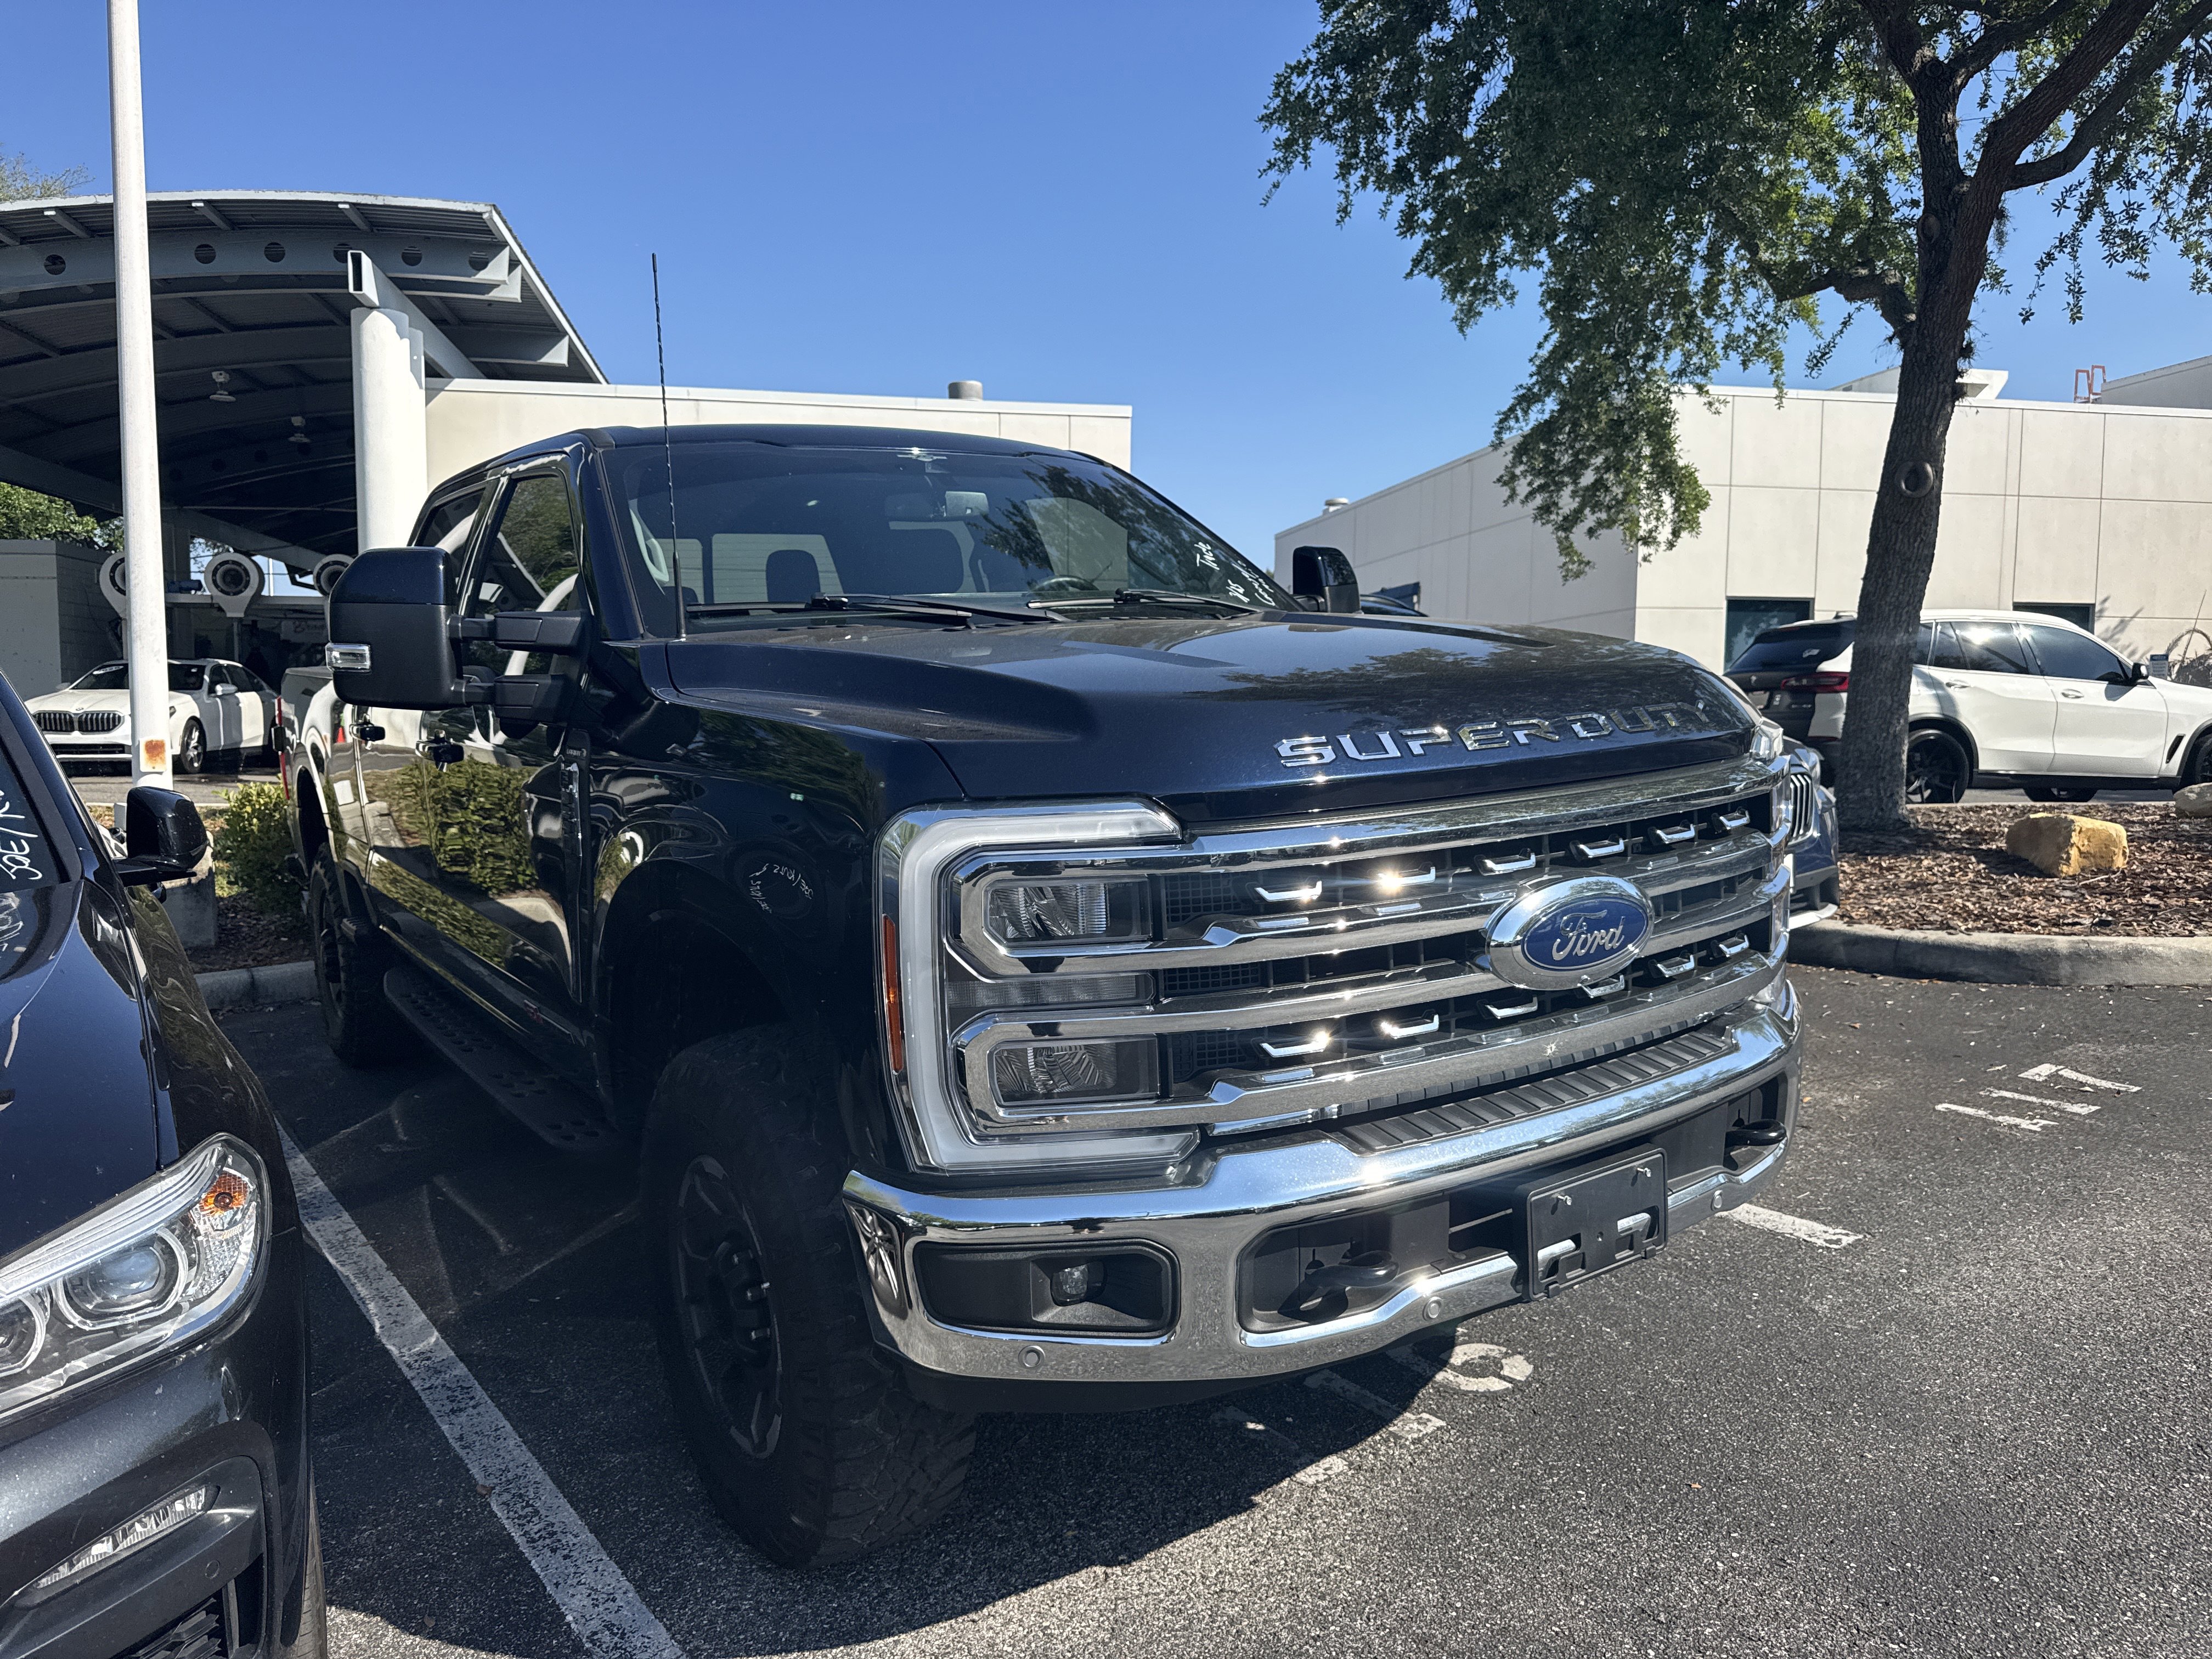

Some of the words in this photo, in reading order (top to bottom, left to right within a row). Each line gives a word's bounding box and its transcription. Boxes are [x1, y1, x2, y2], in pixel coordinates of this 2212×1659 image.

[1274, 719, 1560, 768] SUPER
[1565, 700, 1709, 740] DUTY
[1552, 910, 1624, 960] Ford
